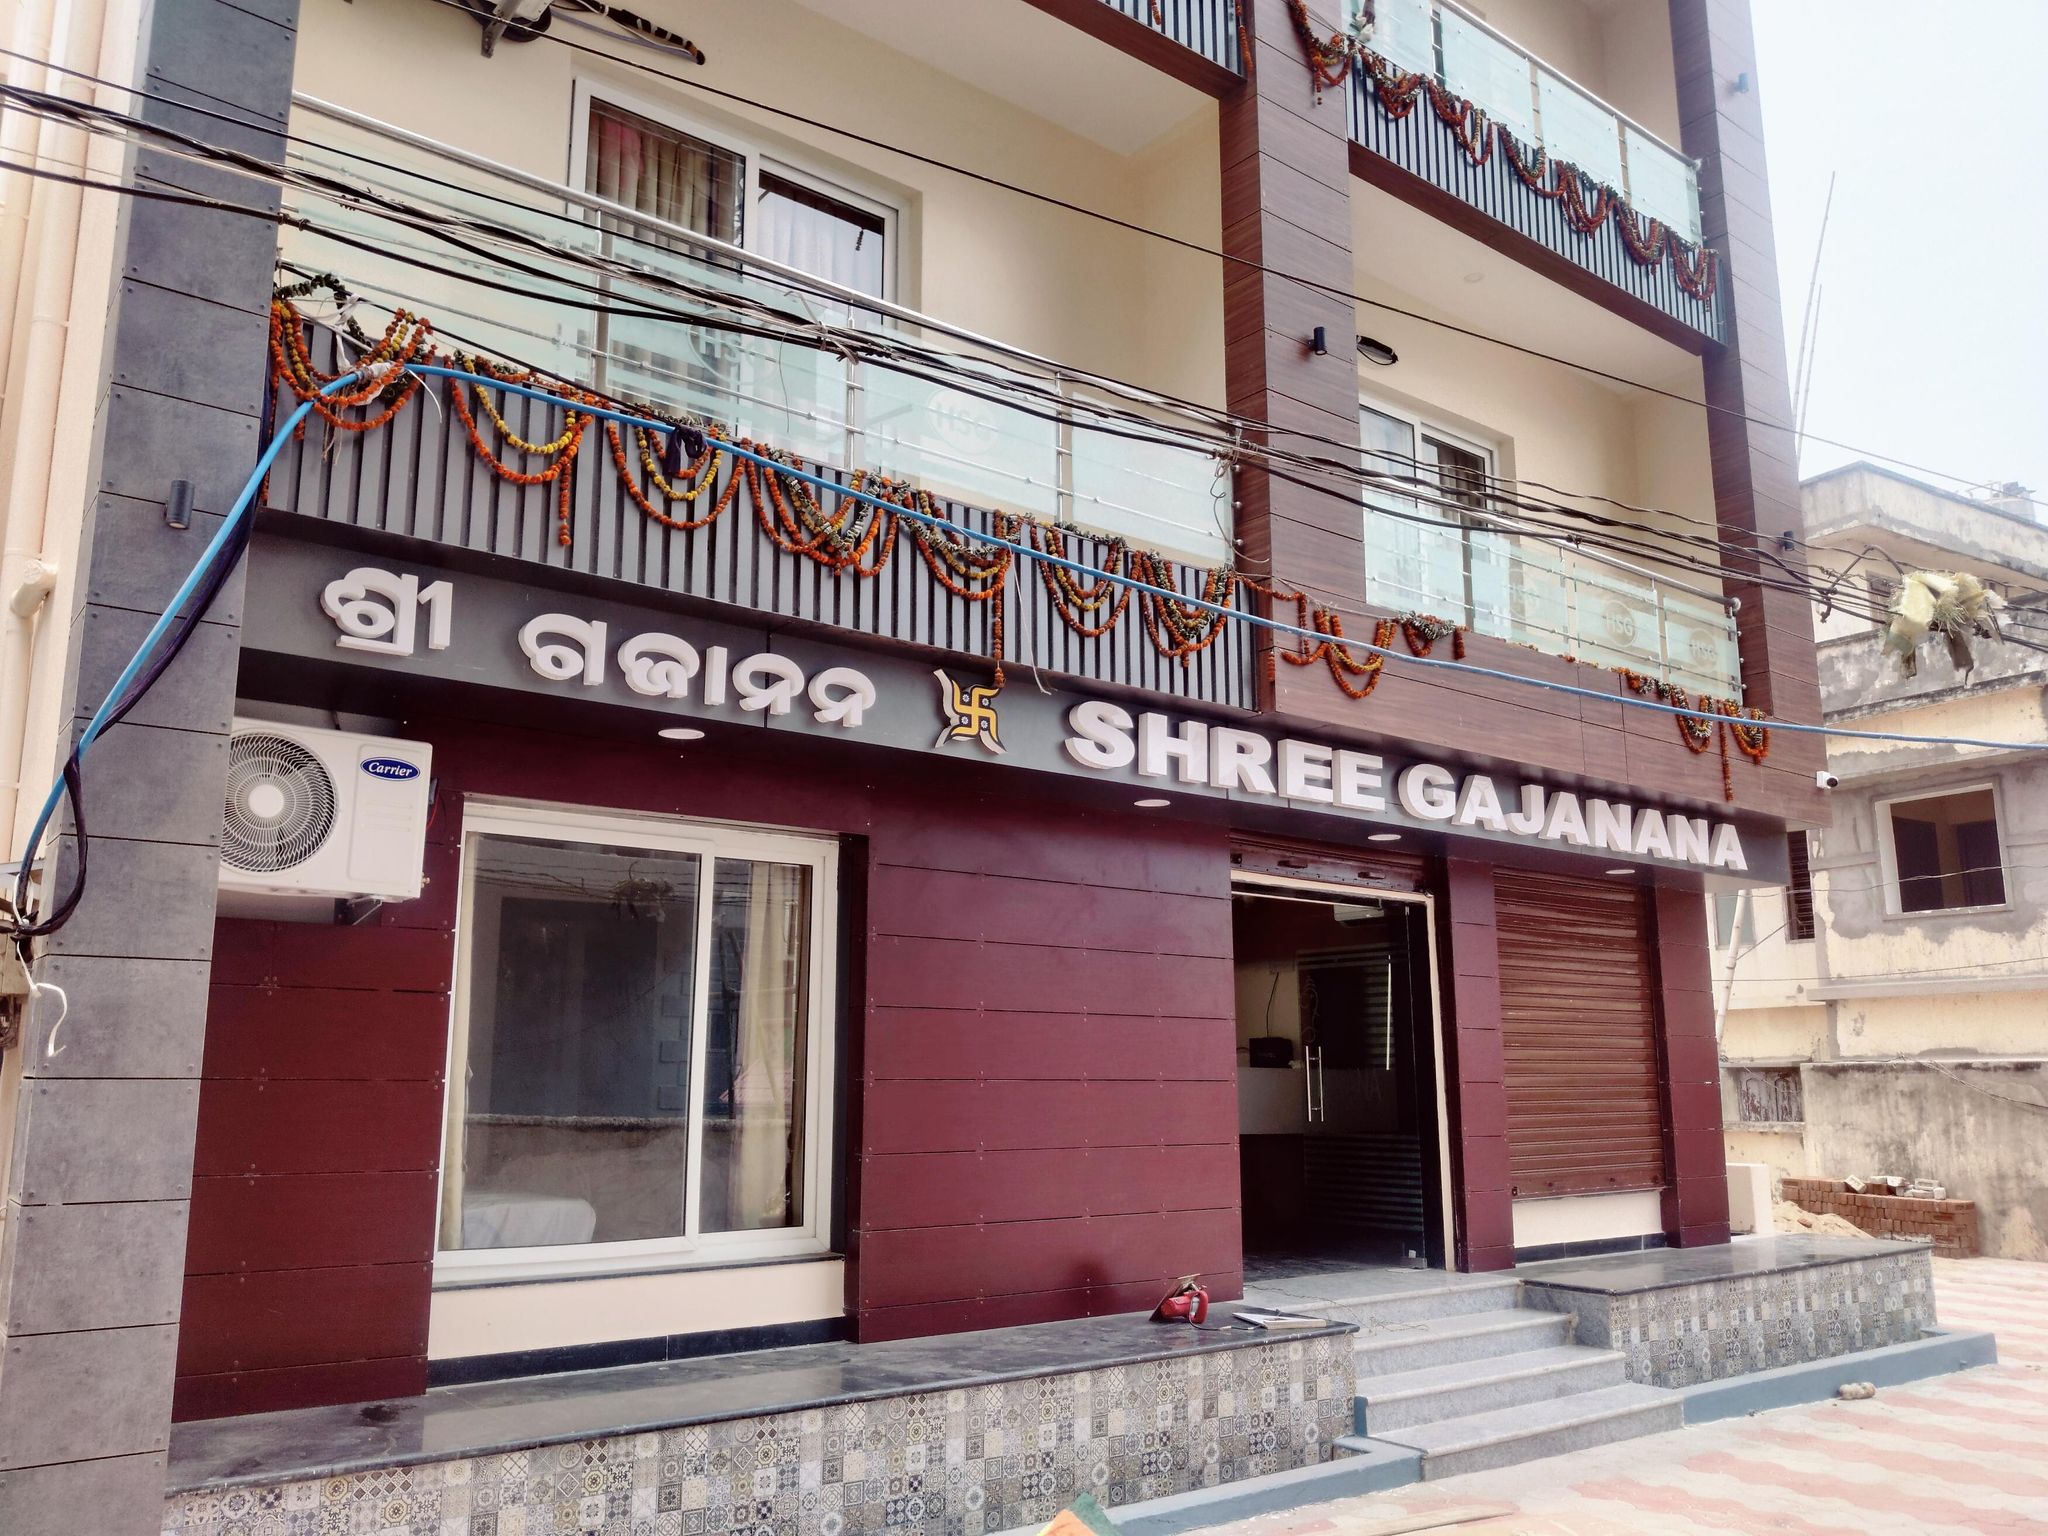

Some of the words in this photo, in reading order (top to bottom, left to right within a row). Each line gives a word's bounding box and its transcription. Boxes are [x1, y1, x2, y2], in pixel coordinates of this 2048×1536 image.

[321, 567, 454, 656] ଶ୍ରୀ
[518, 613, 876, 728] ଗଜାନନ
[368, 761, 413, 777] Carrier
[1064, 700, 1386, 811] SHREE
[1398, 764, 1749, 871] GAJANANA
